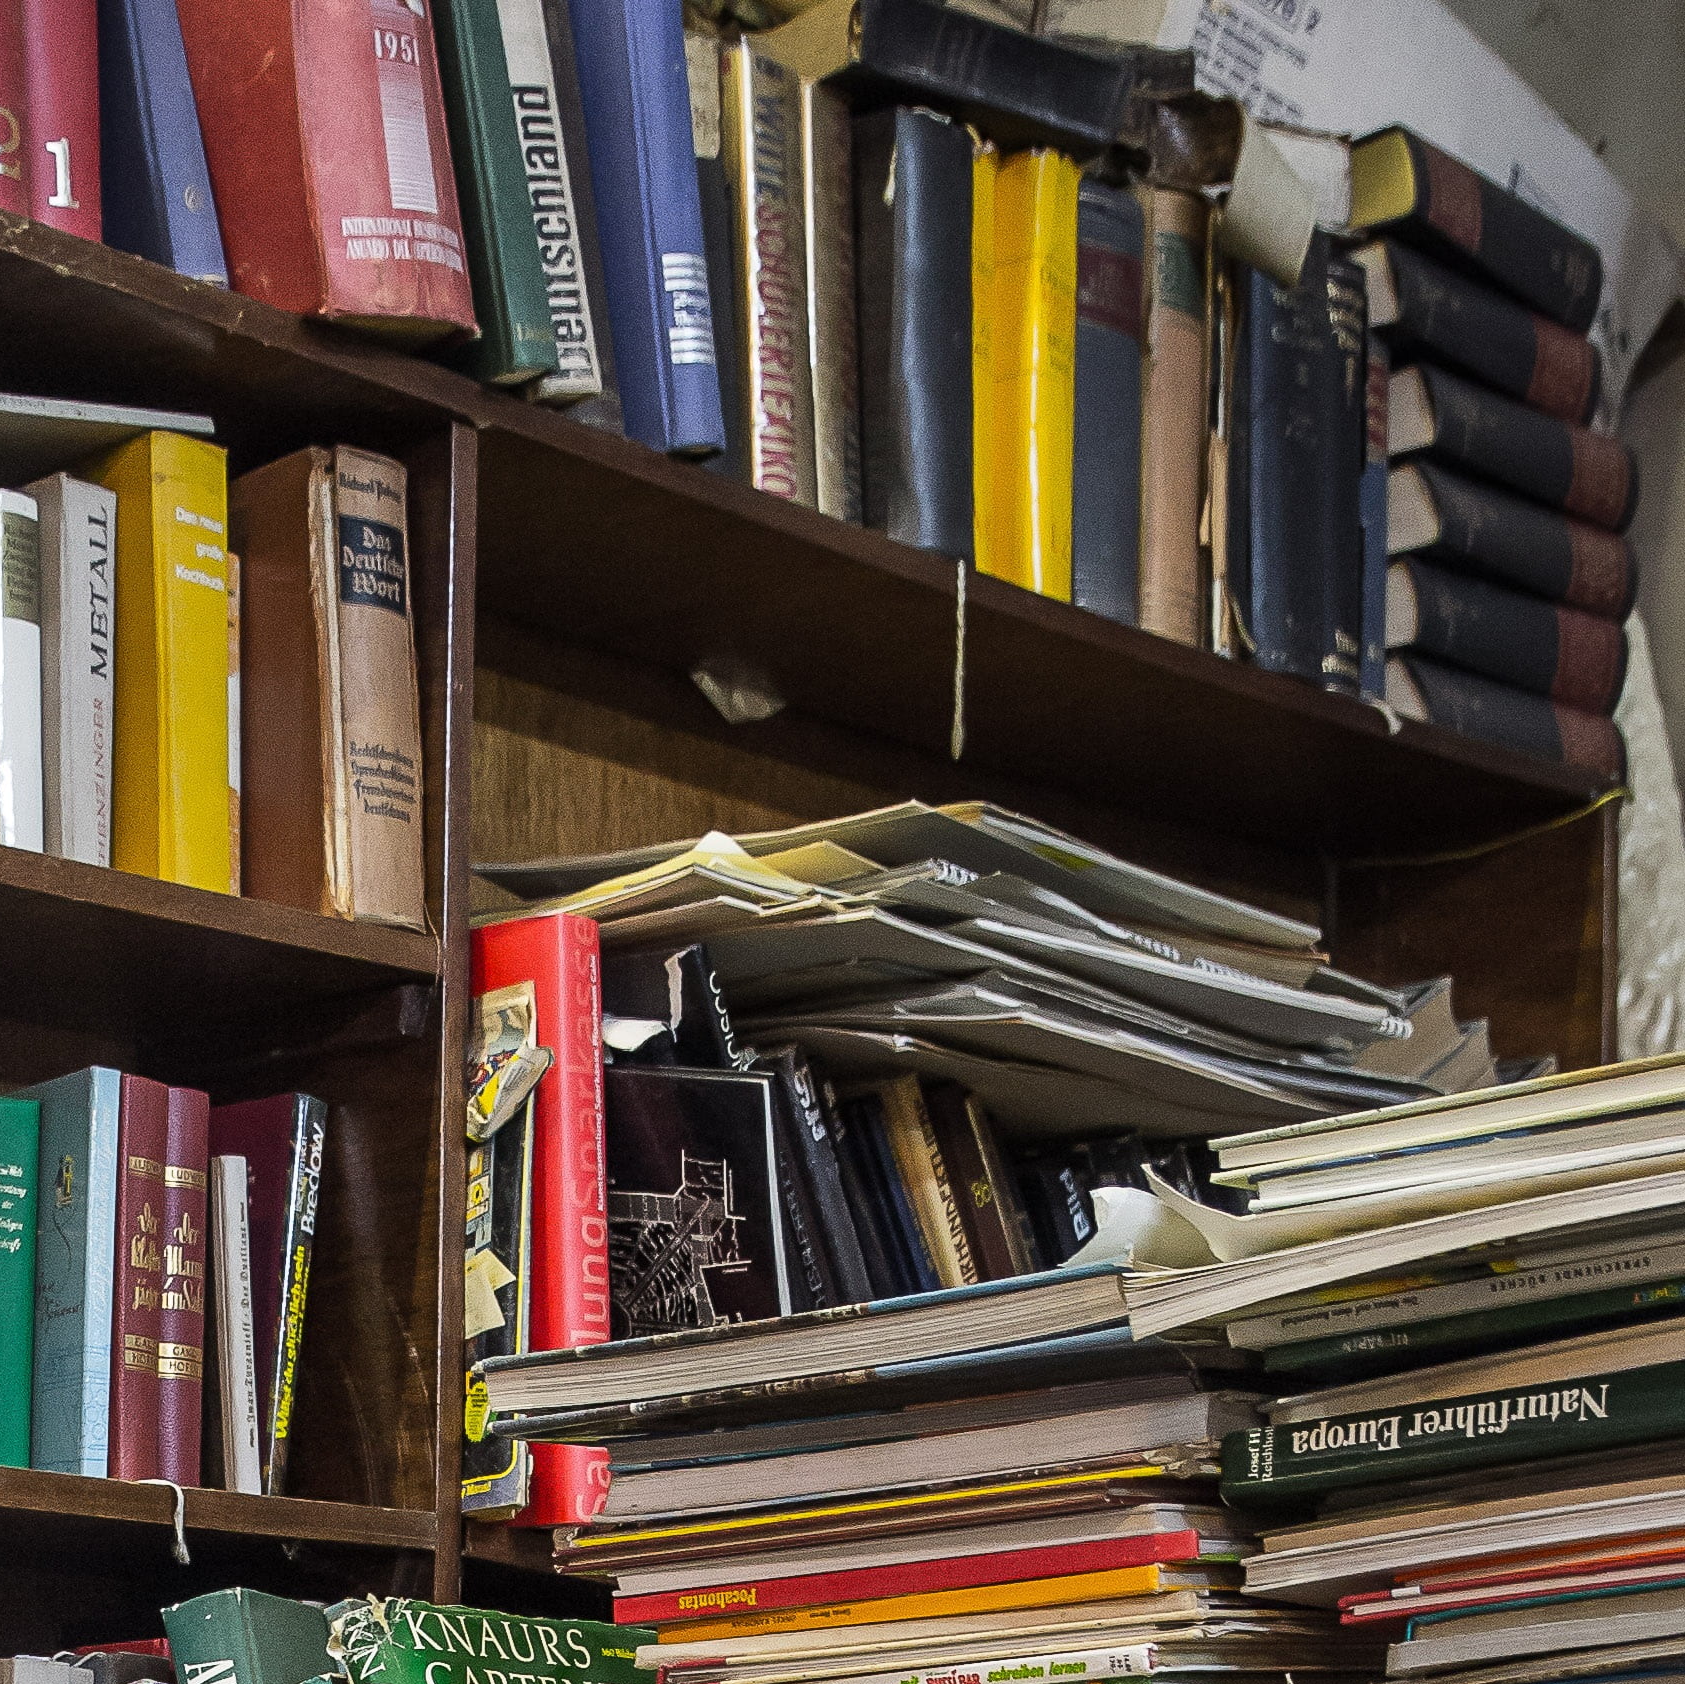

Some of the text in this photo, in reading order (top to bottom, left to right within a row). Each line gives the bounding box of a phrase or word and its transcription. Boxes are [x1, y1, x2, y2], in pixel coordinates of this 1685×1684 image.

[374, 28, 420, 66] 1951
[46, 137, 80, 209] 1
[89, 504, 111, 680] METALL
[300, 1123, 325, 1235] Bredow
[1291, 1384, 1609, 1456] Naturführer Europa
[677, 1586, 758, 1612] Pocahontas
[407, 1609, 591, 1670] KNAURS
[986, 1659, 1087, 1684] schreiben lernen
